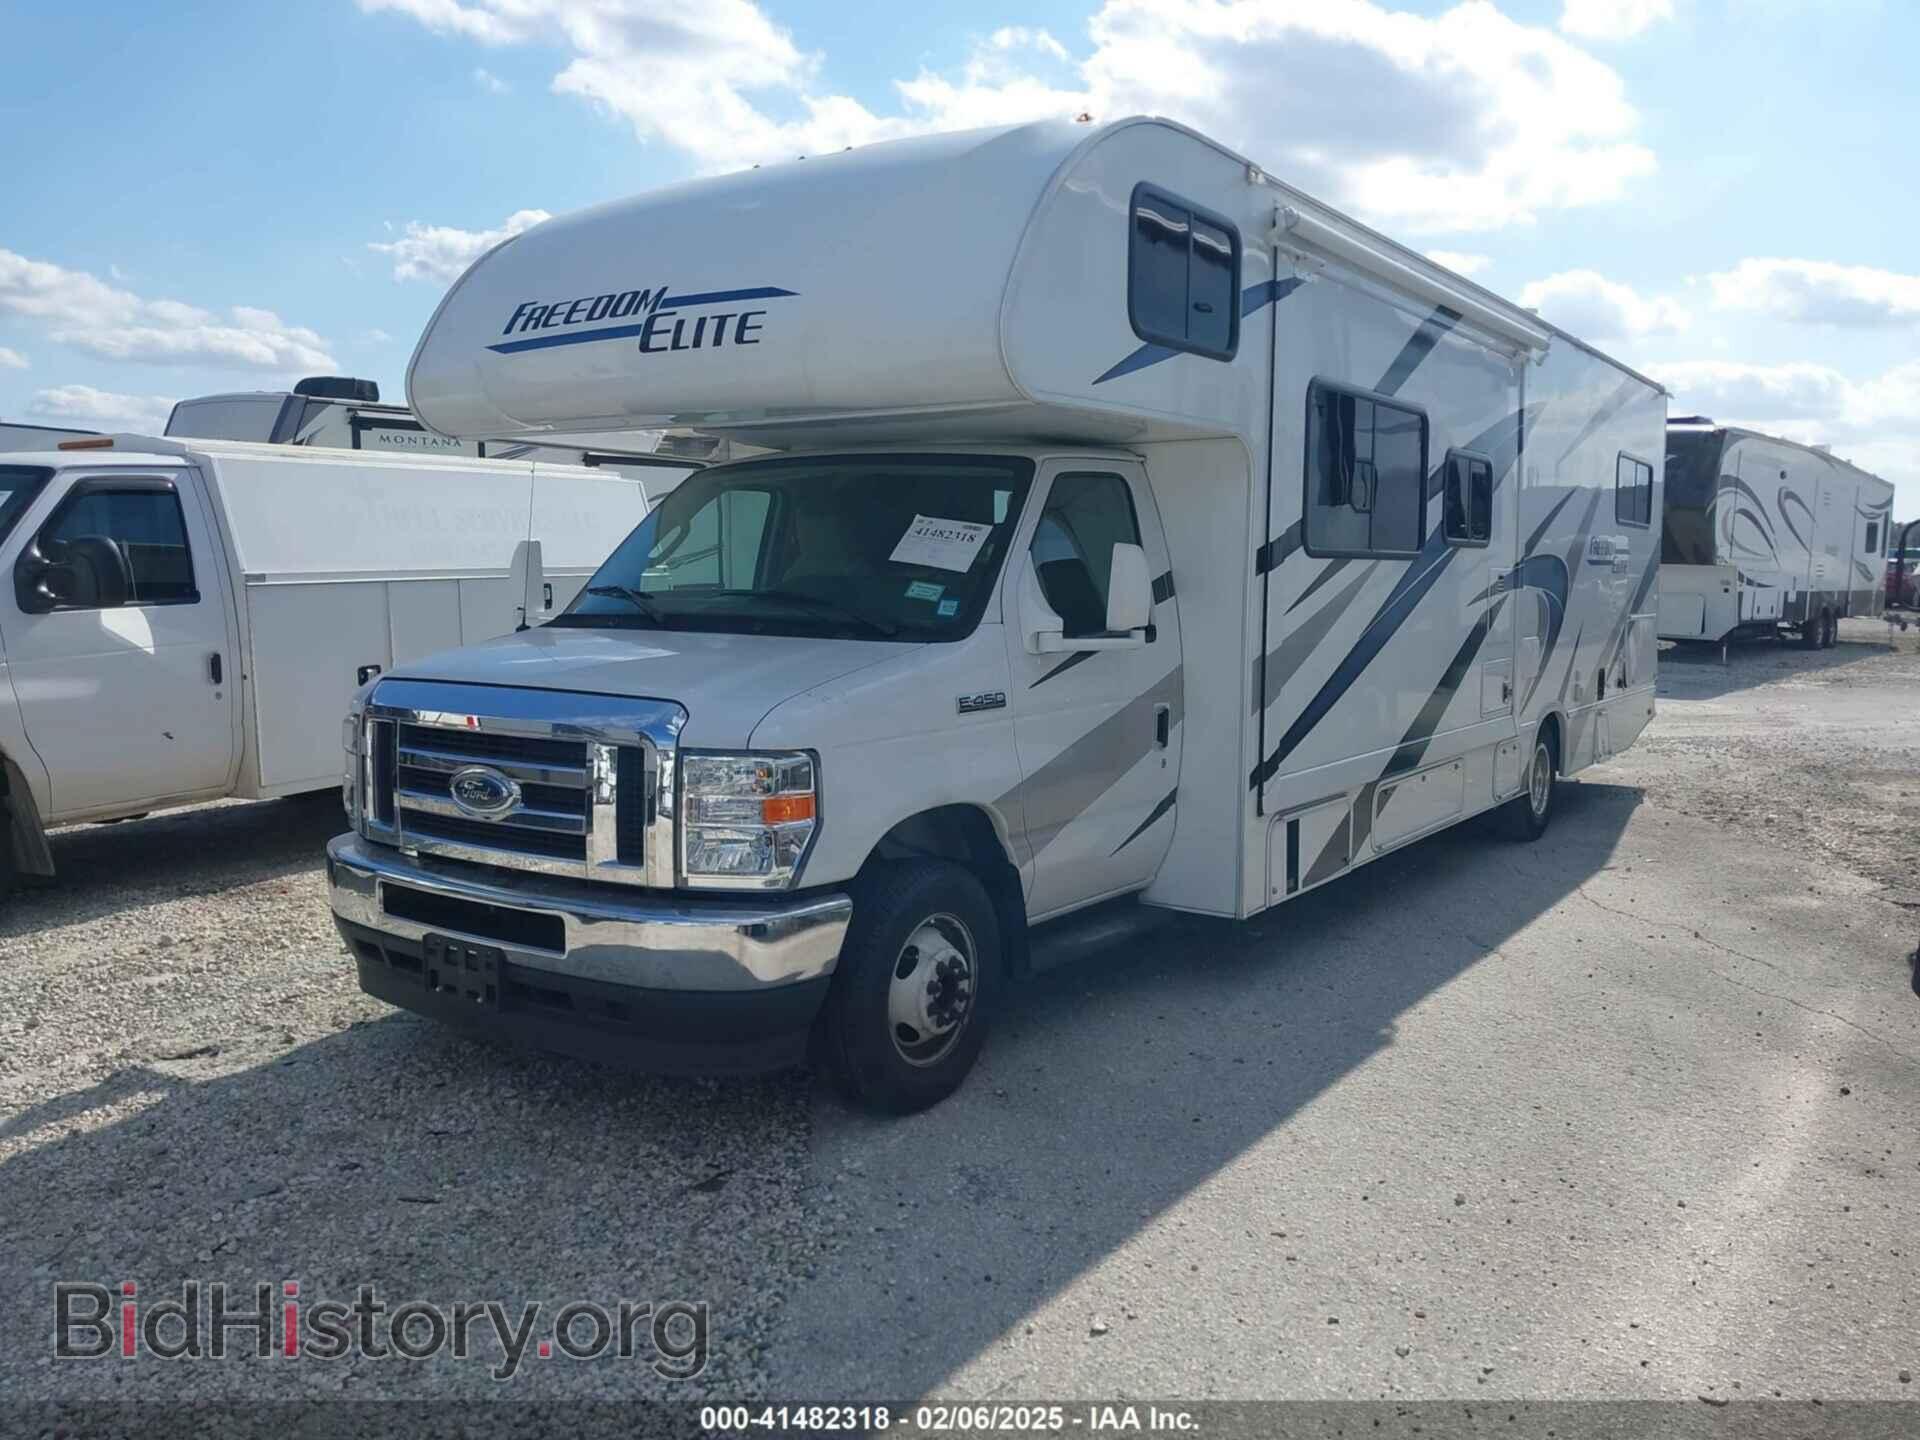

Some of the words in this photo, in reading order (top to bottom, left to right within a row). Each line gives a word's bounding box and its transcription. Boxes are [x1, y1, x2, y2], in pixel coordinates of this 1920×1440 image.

[502, 286, 669, 335] FREEDOM
[639, 310, 767, 353] ELITE
[379, 434, 463, 448] MONTANA
[462, 780, 490, 801] Ford
